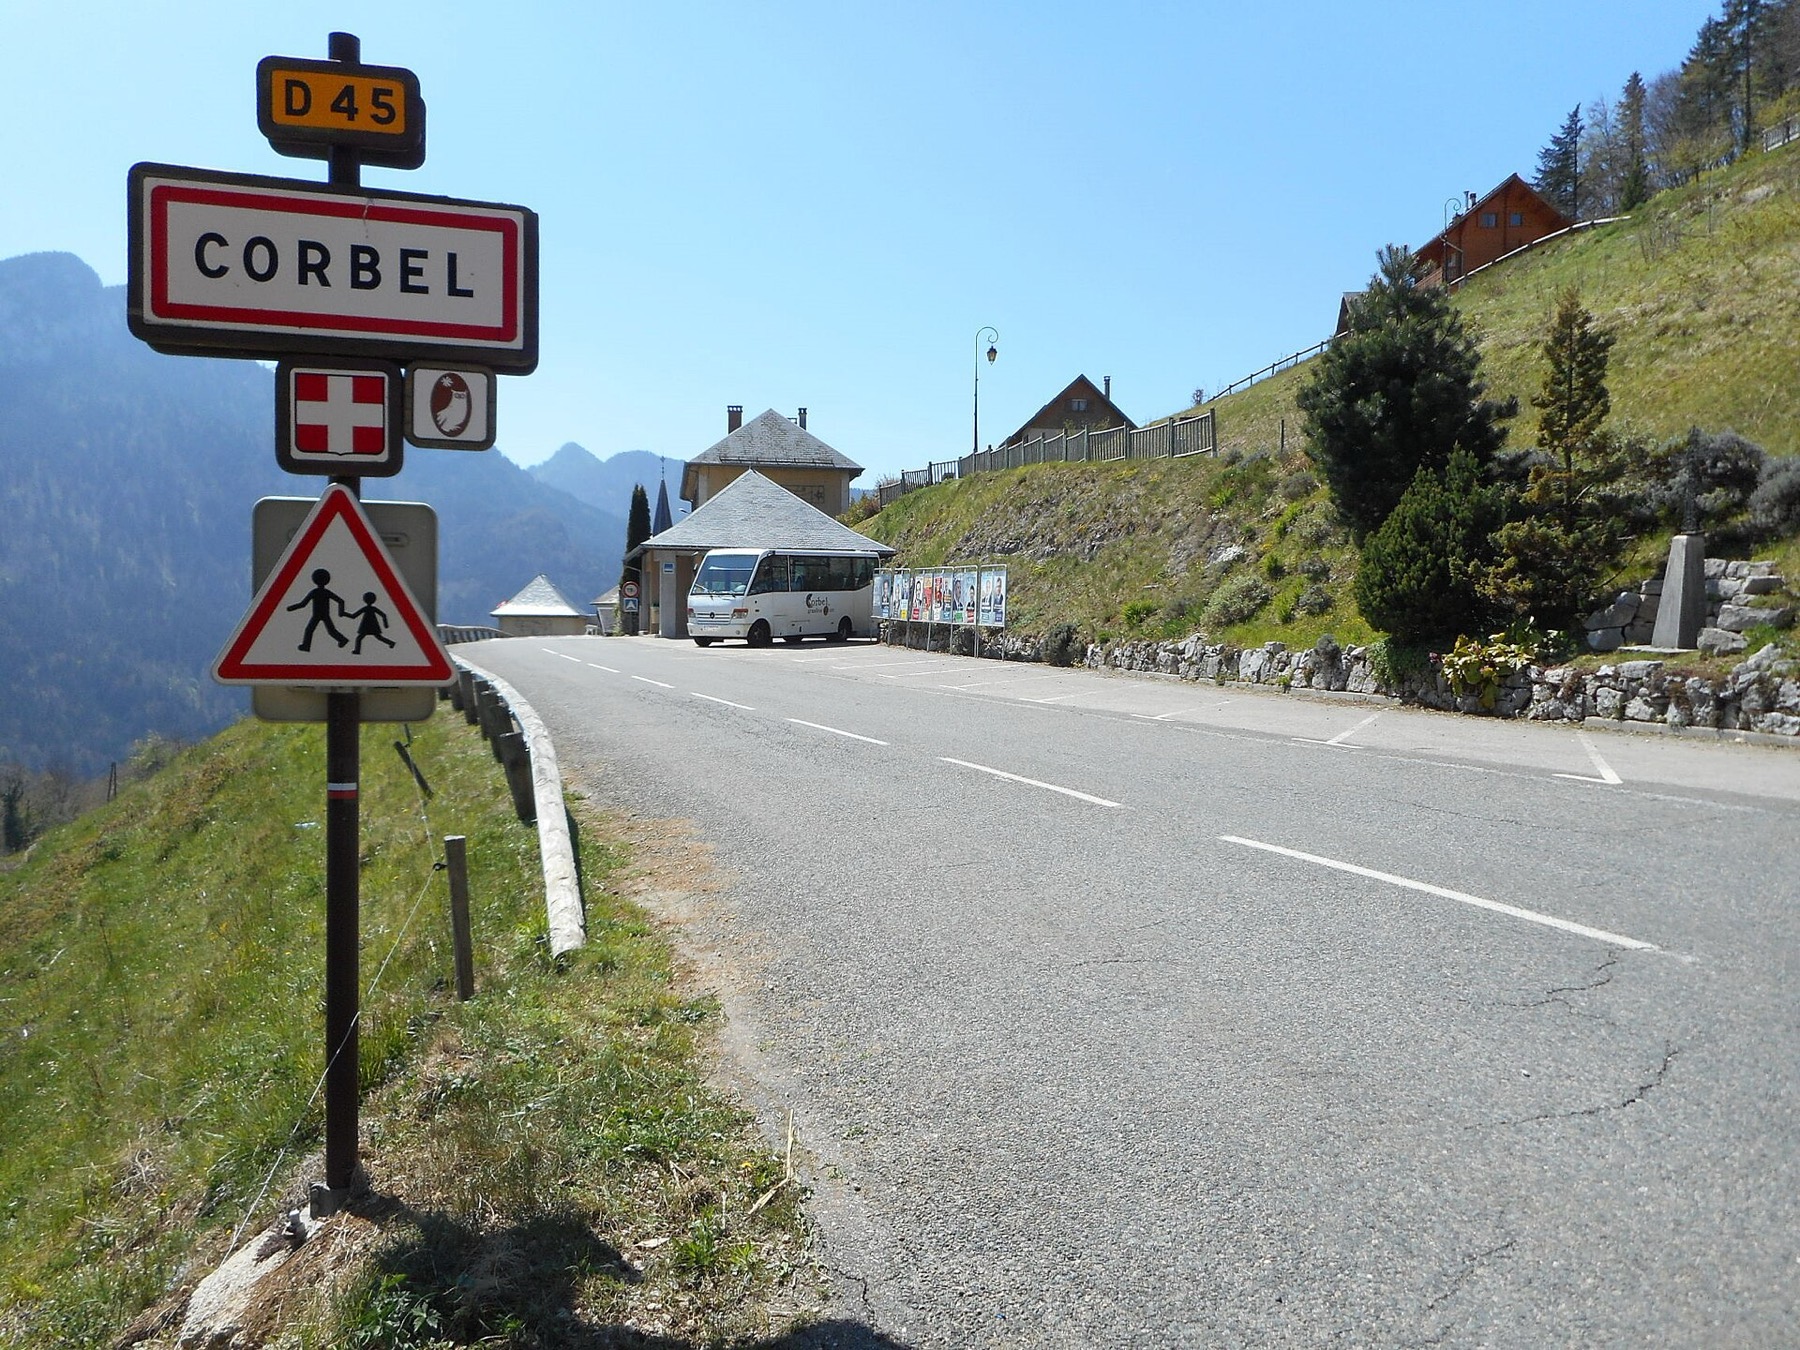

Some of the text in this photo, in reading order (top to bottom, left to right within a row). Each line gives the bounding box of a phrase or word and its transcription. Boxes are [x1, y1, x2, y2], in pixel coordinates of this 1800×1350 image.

[284, 78, 397, 126] D 45
[193, 232, 474, 299] CORBEL
